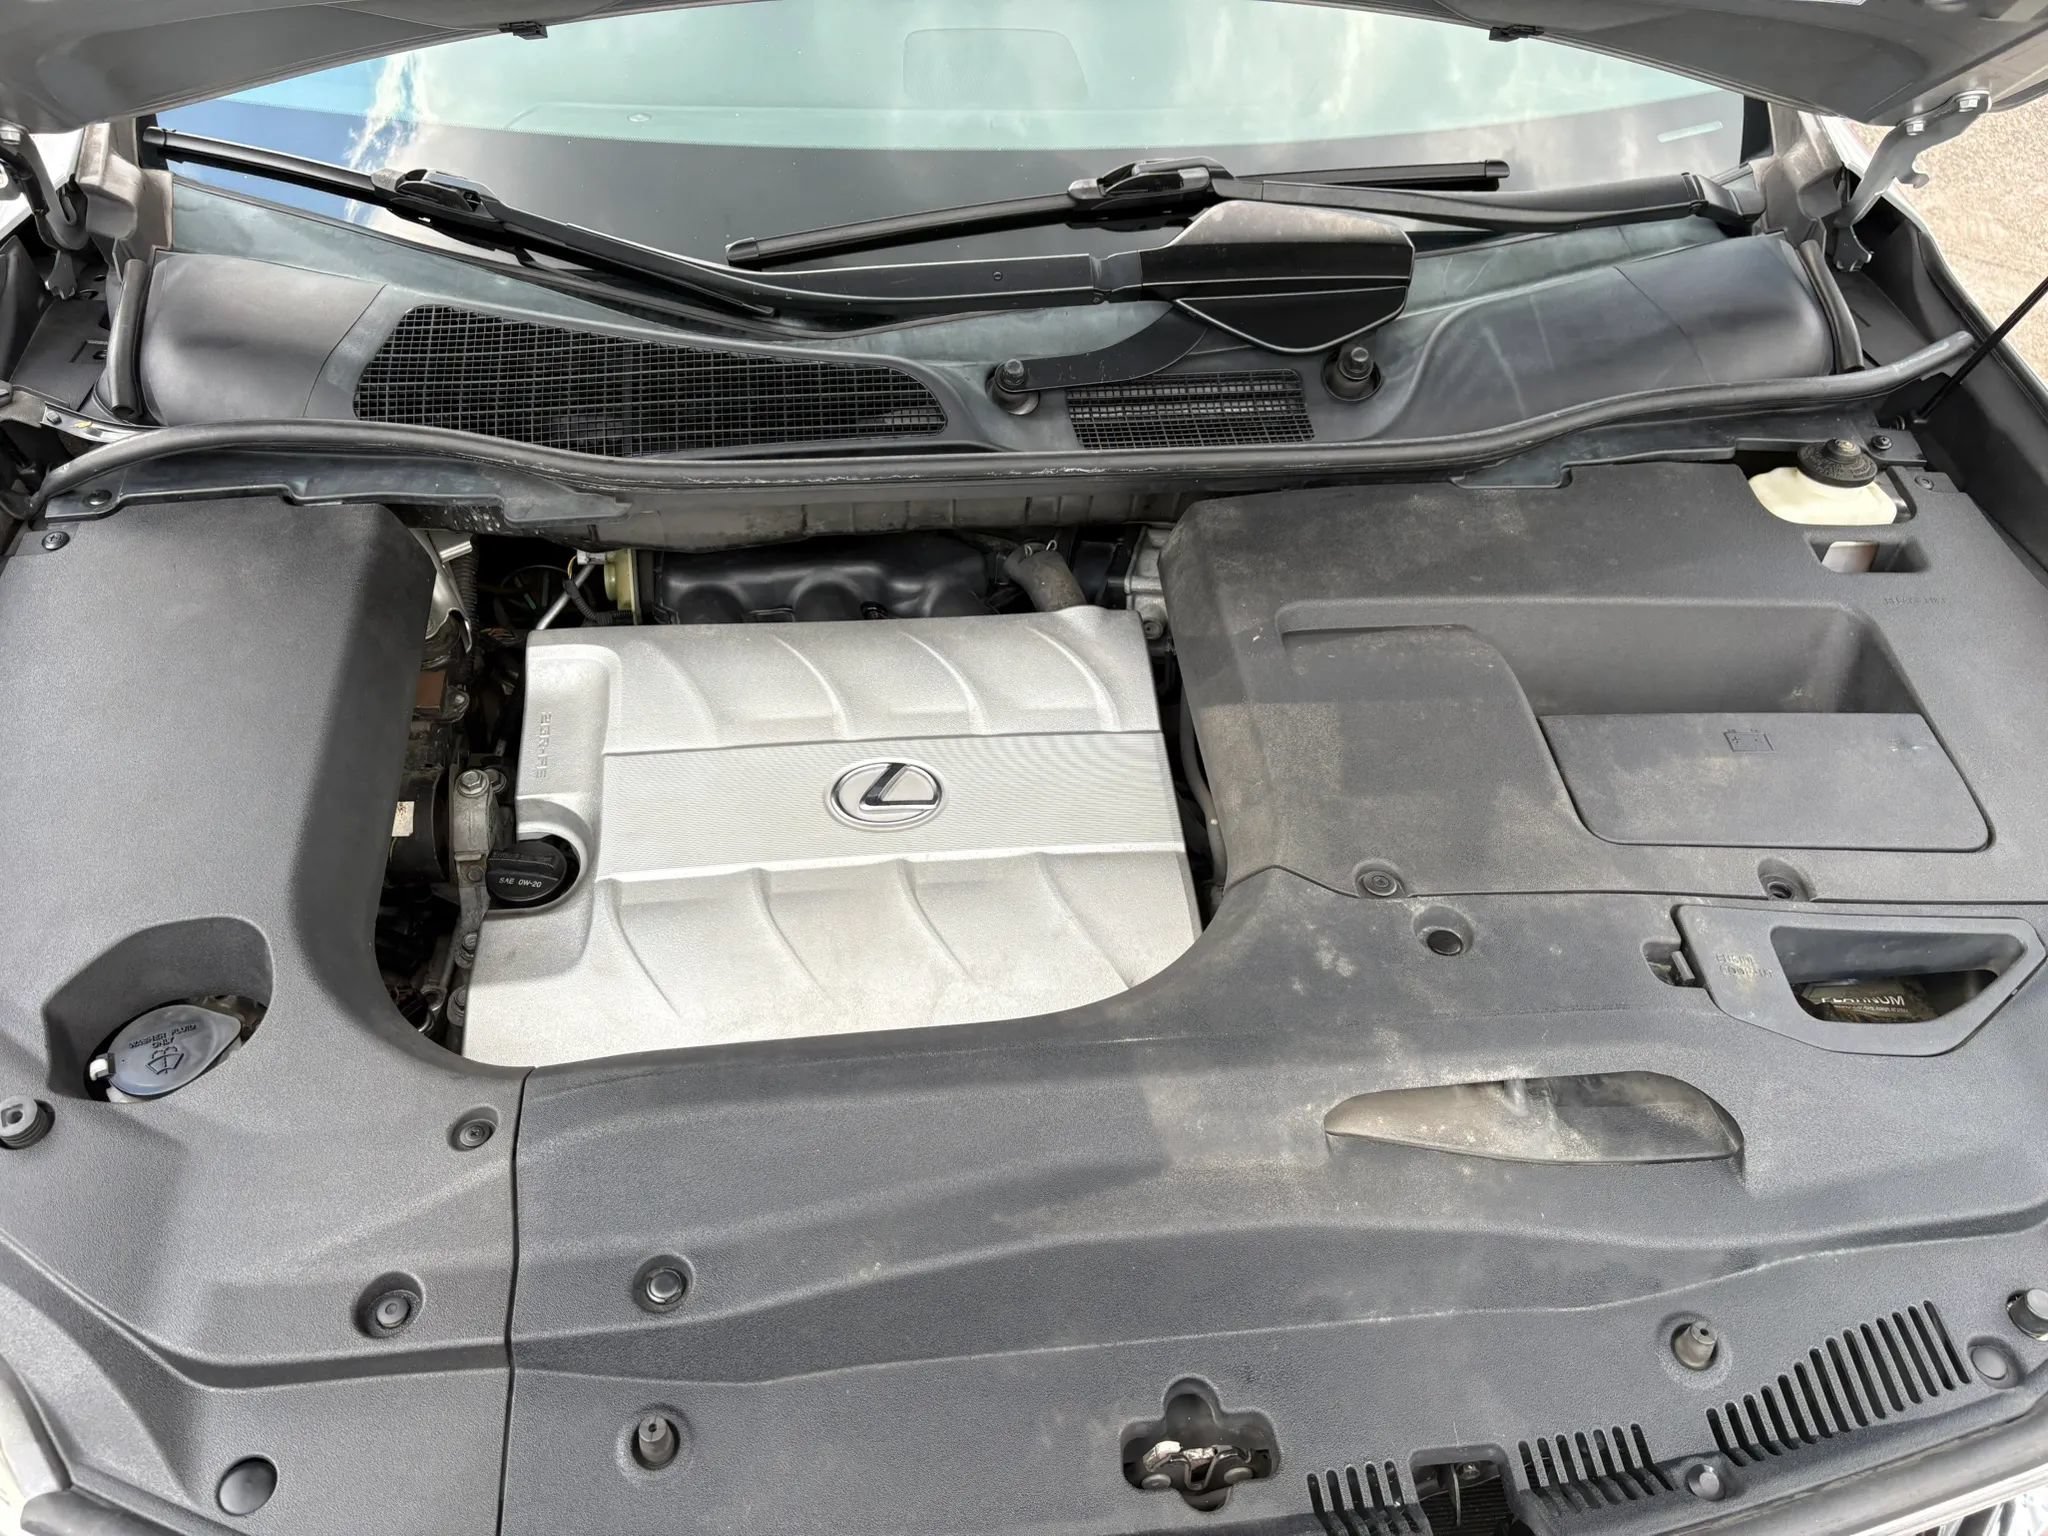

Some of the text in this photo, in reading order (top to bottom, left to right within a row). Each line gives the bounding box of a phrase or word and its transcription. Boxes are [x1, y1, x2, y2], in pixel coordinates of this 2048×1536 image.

[499, 877, 542, 888] SAE 0W-20
[171, 1024, 198, 1037] FLUID
[152, 1036, 175, 1049] ONLY
